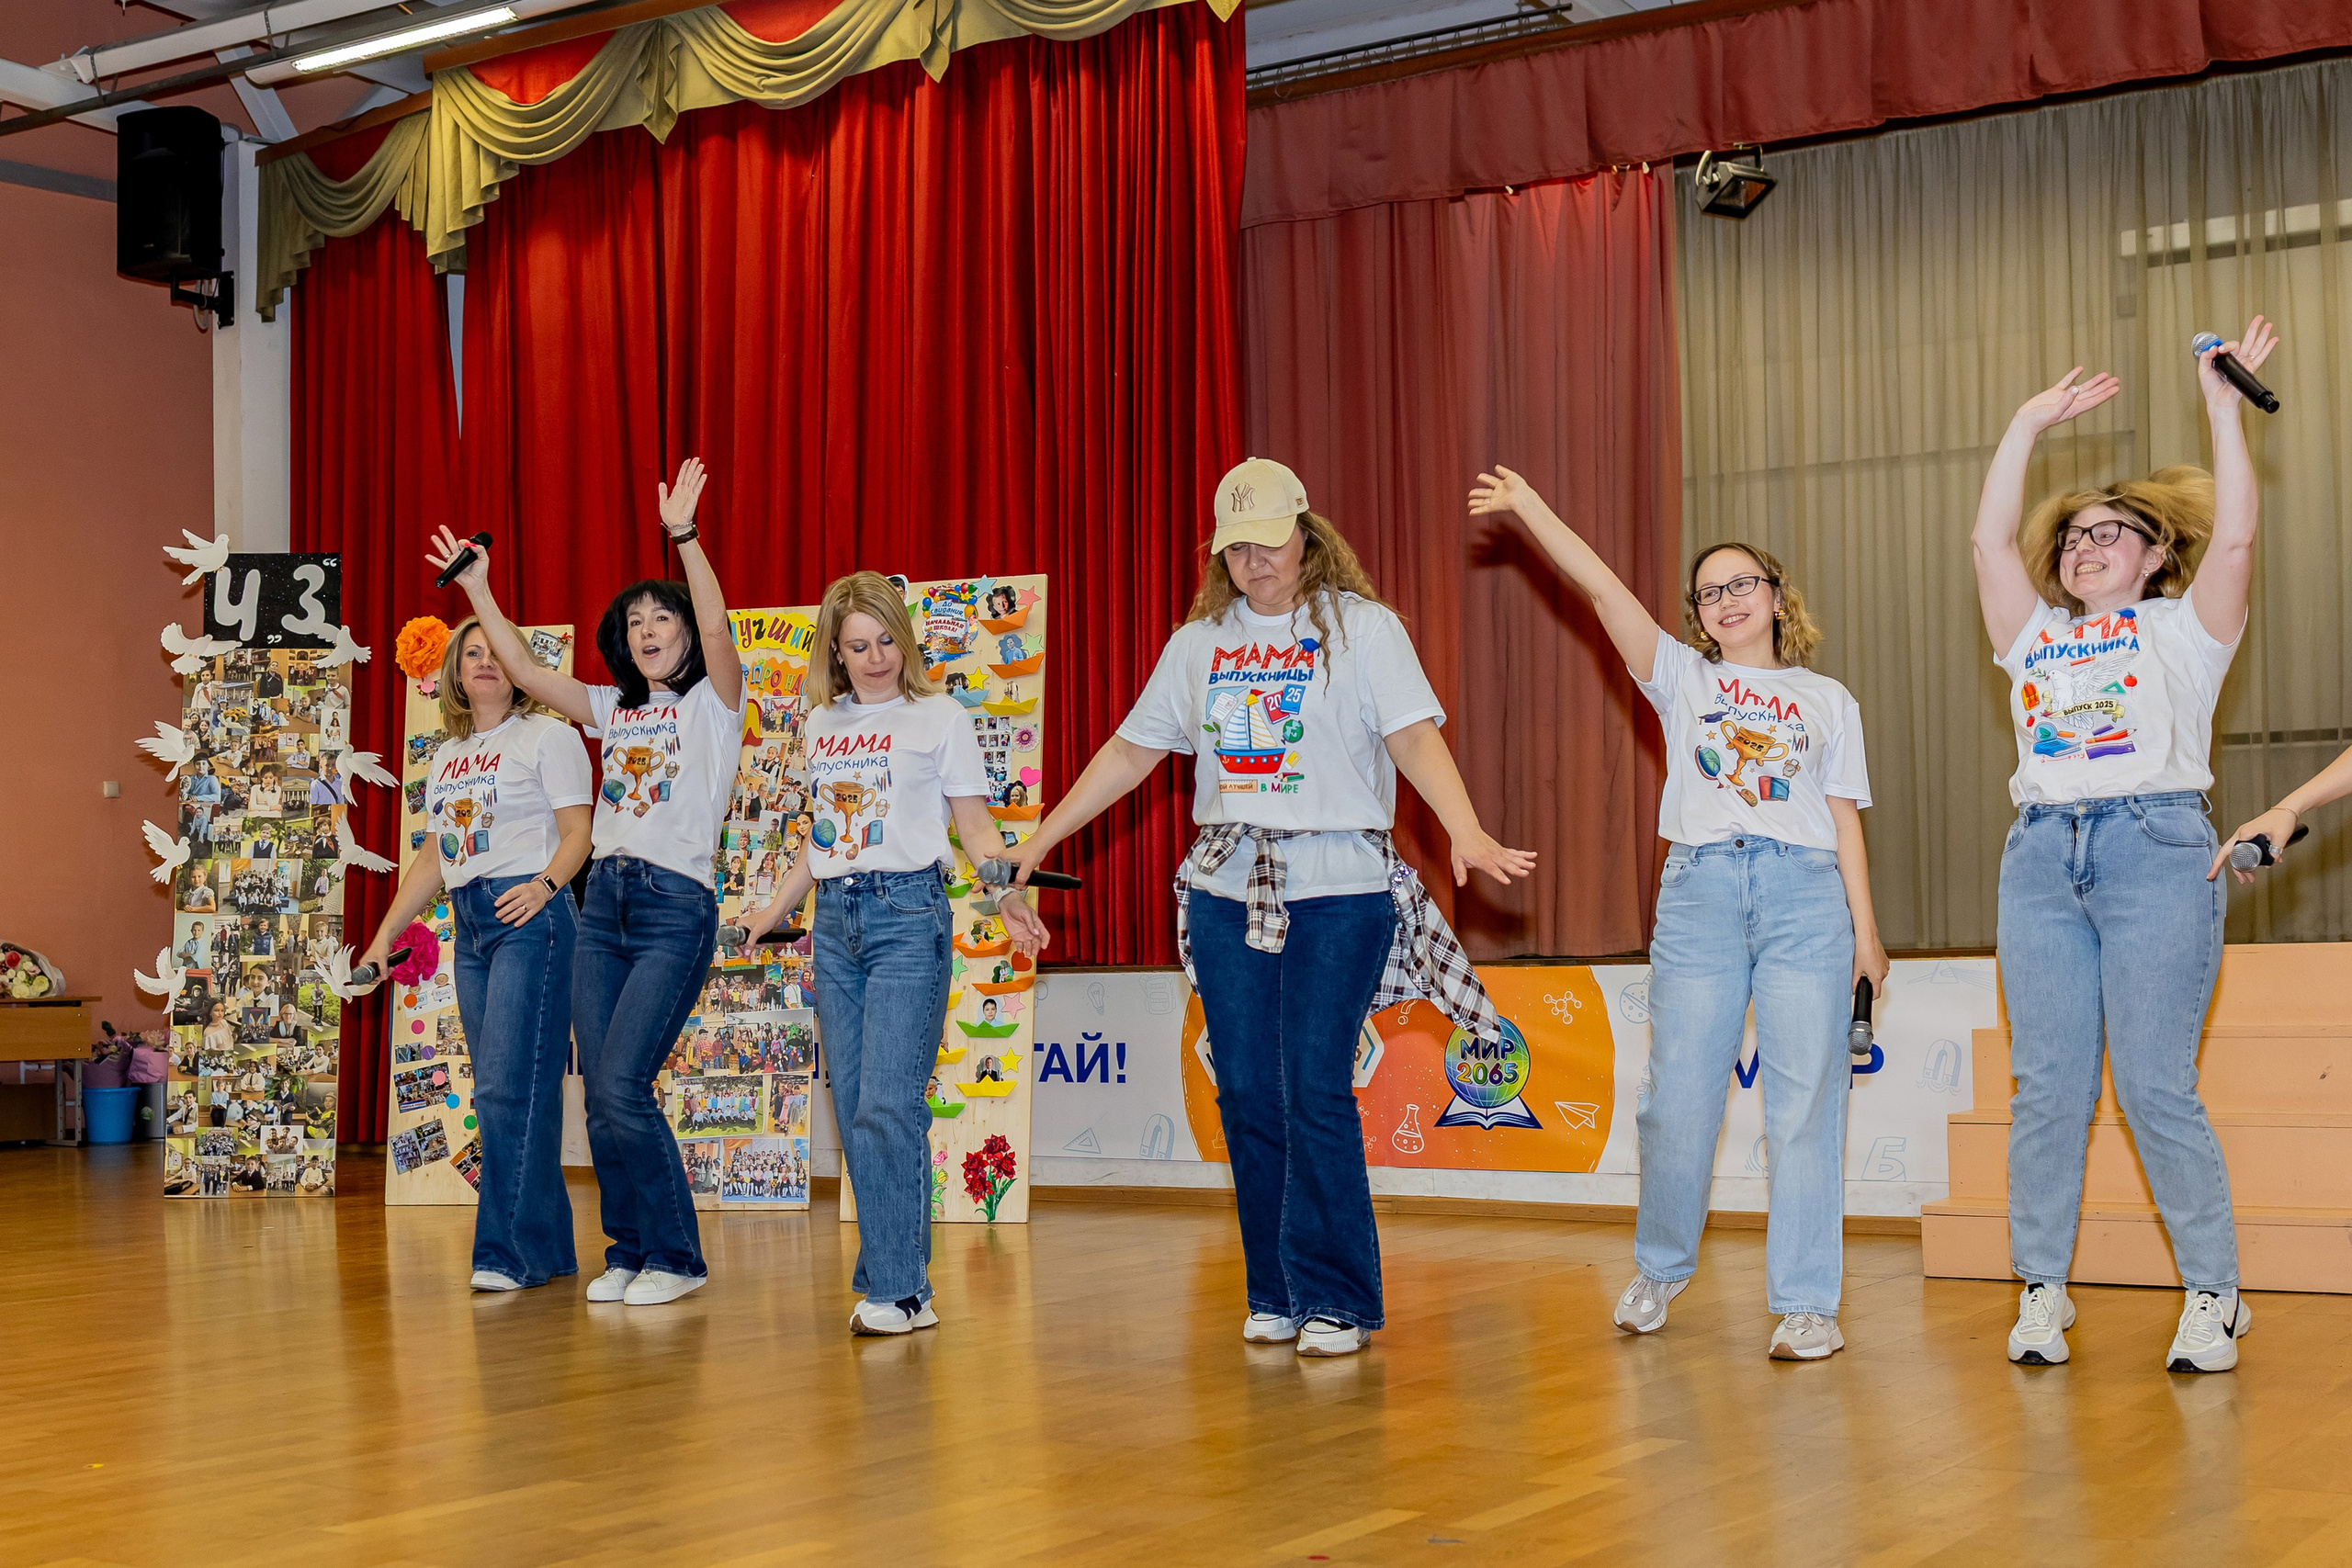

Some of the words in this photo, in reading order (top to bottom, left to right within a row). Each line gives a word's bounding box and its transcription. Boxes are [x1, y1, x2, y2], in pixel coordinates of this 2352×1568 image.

[1231, 482, 1255, 513] NY
[1211, 641, 1315, 672] МАМА
[750, 664, 782, 690] ПРО
[1208, 668, 1314, 684] ВЫПУСКНИЦЫ
[1267, 694, 1281, 712] 20
[1284, 687, 1303, 705] 25
[2063, 703, 2093, 716] ВЫПУСК
[2095, 700, 2114, 709] 2025
[809, 733, 891, 761] МАМА
[1736, 736, 1764, 752] 2025
[438, 750, 502, 783] МАМА
[628, 756, 647, 766] 2025
[811, 756, 888, 776] ыпускника
[835, 793, 859, 804] 2025
[1260, 783, 1268, 793] В
[1460, 1037, 1516, 1061] МИР
[1456, 1062, 1520, 1086] 2065
